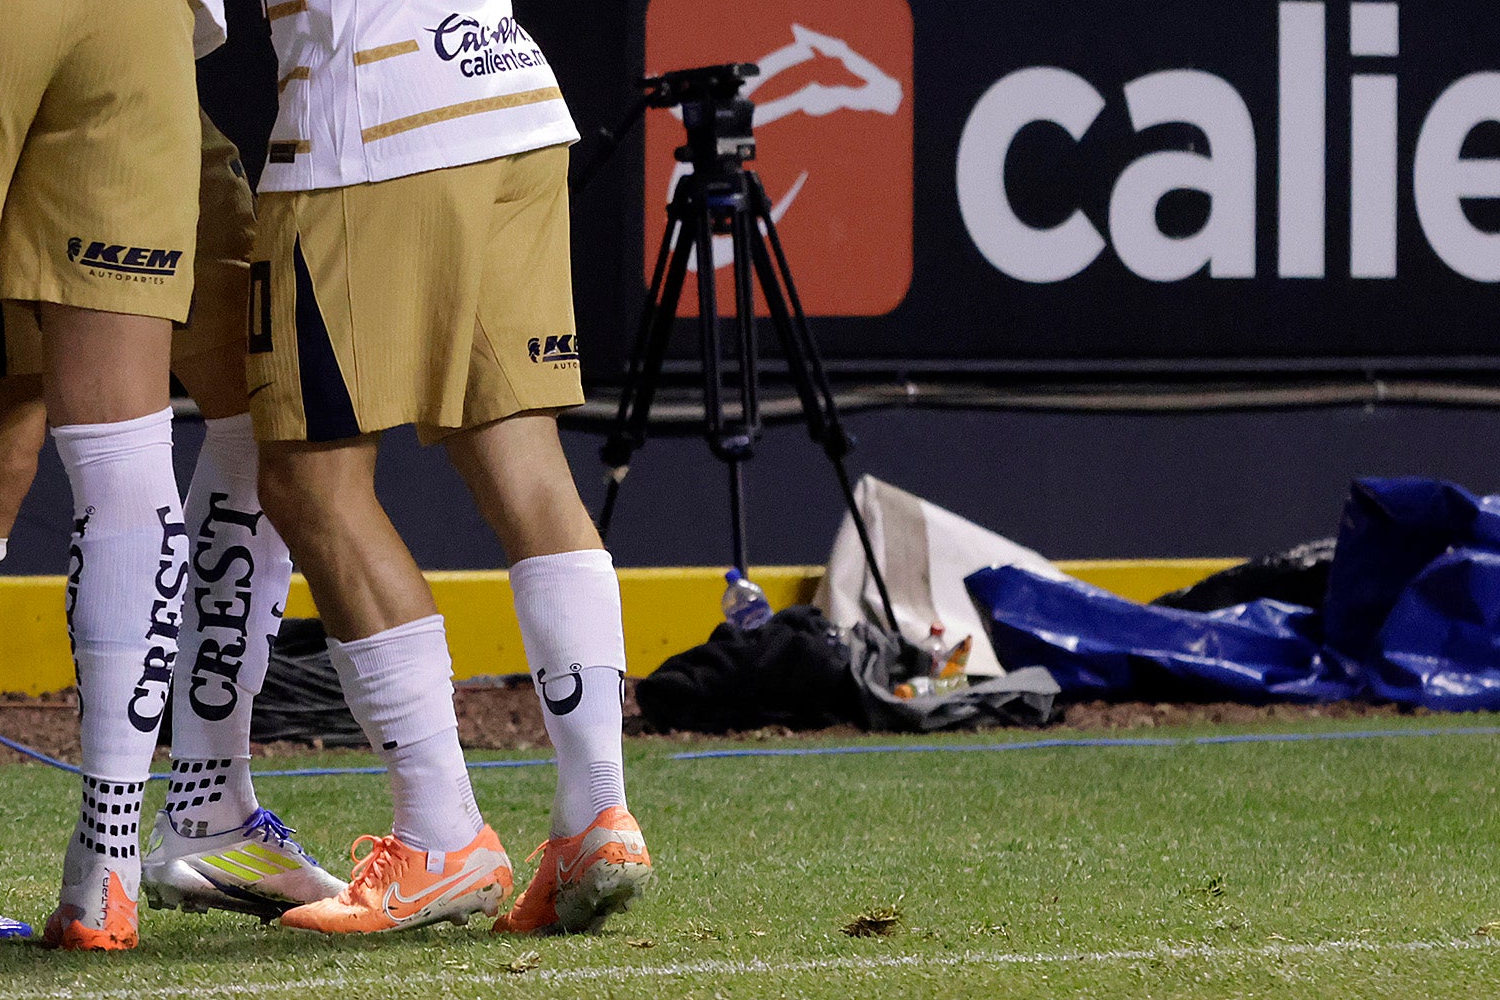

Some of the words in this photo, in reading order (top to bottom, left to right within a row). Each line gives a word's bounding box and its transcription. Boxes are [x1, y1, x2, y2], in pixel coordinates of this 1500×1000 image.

[83, 241, 183, 269] KEM
[127, 504, 190, 733] CREST
[188, 493, 264, 722] CREST
